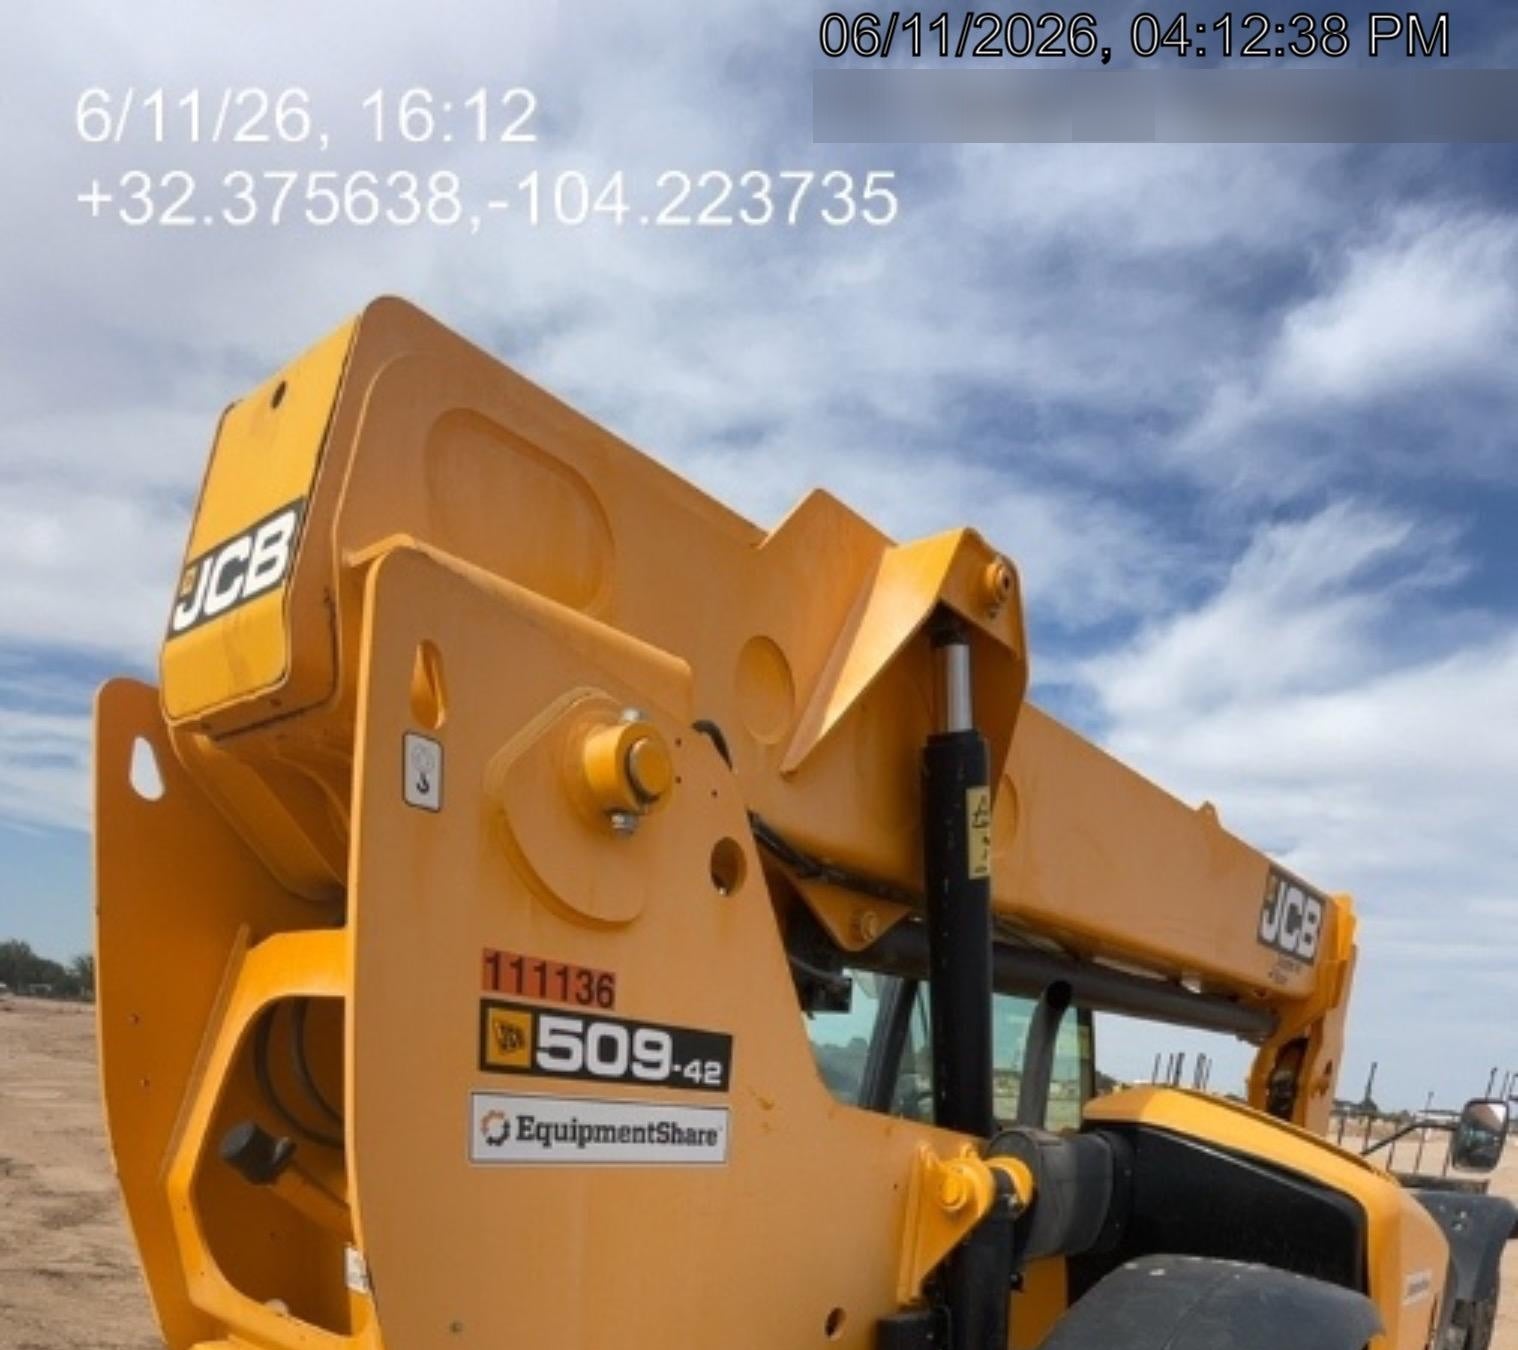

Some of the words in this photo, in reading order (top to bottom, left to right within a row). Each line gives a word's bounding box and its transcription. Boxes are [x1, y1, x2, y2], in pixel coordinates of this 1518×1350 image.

[172, 510, 297, 631] JCB
[1262, 881, 1321, 958] JCB
[486, 951, 615, 1008] 111136
[536, 1015, 722, 1085] 509-42
[515, 1113, 718, 1150] EquipmentShare
